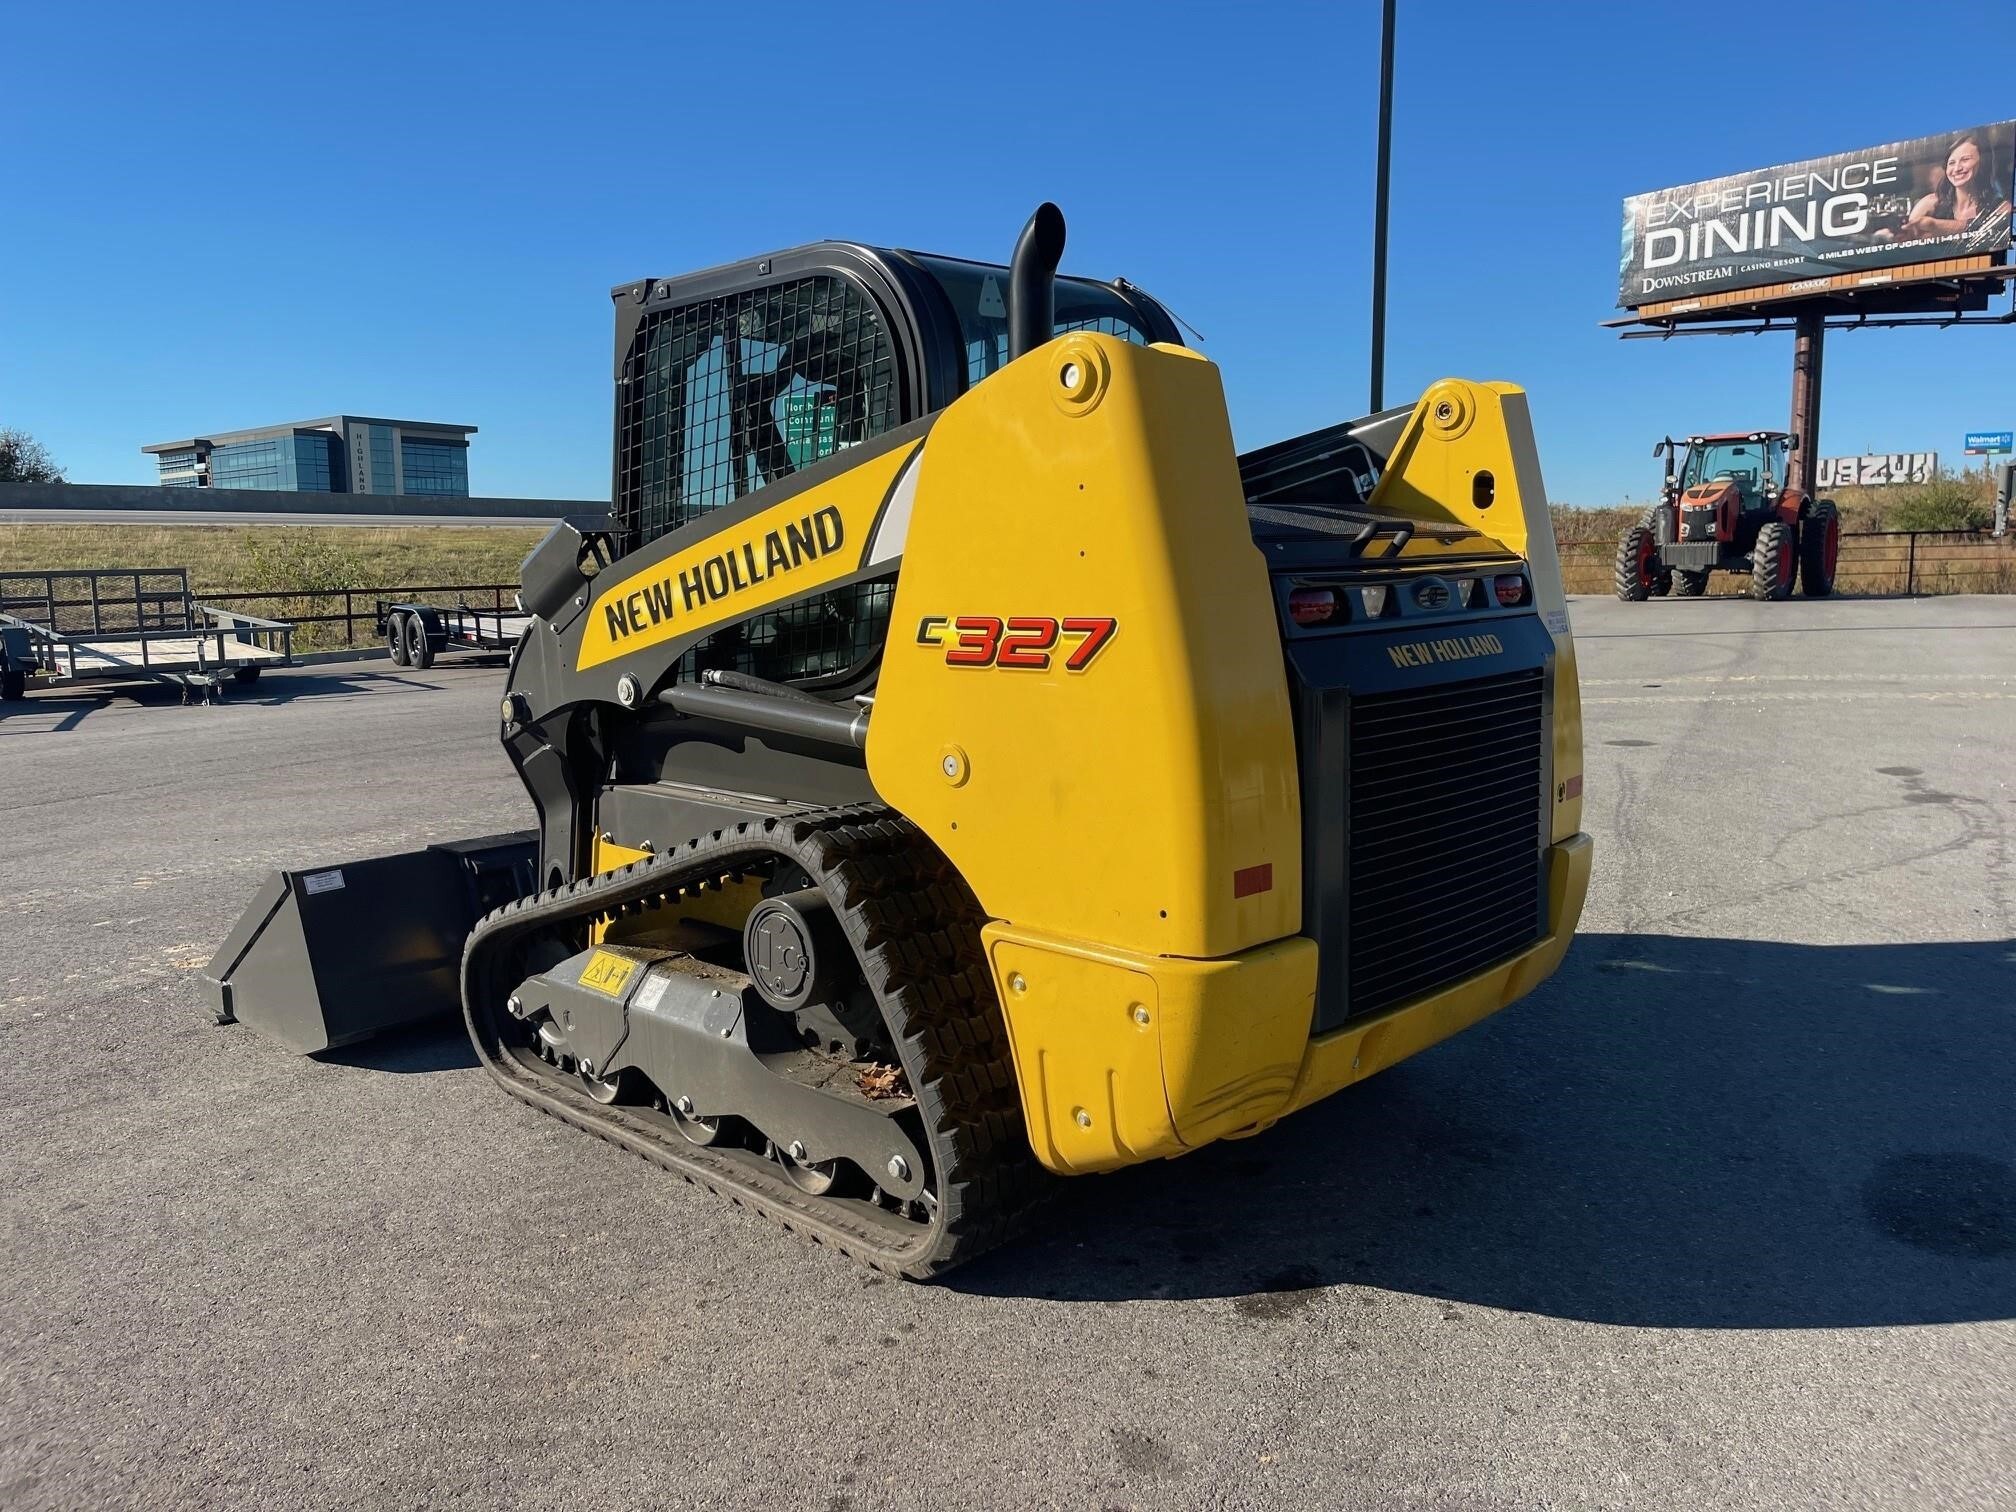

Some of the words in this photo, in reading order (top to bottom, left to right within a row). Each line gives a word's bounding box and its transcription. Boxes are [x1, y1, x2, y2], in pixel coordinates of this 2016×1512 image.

[1646, 157, 1898, 227] EXPERIENCE
[1644, 193, 1868, 269] DINING
[1825, 249, 1855, 259] MILES
[1855, 244, 1884, 255] WEST
[1885, 243, 1899, 251] OF
[1899, 237, 1936, 249] JOPLIN
[1642, 266, 1732, 293] DOWNSTREAM
[1741, 262, 1771, 273] CASINO
[1773, 256, 1805, 267] RESORT
[789, 436, 833, 445] Arasas
[604, 579, 674, 642] NEW
[679, 504, 845, 611] HOLLAND
[916, 616, 1118, 672] C327
[1387, 643, 1433, 668] NEW
[1430, 634, 1503, 662] HOLLAND
